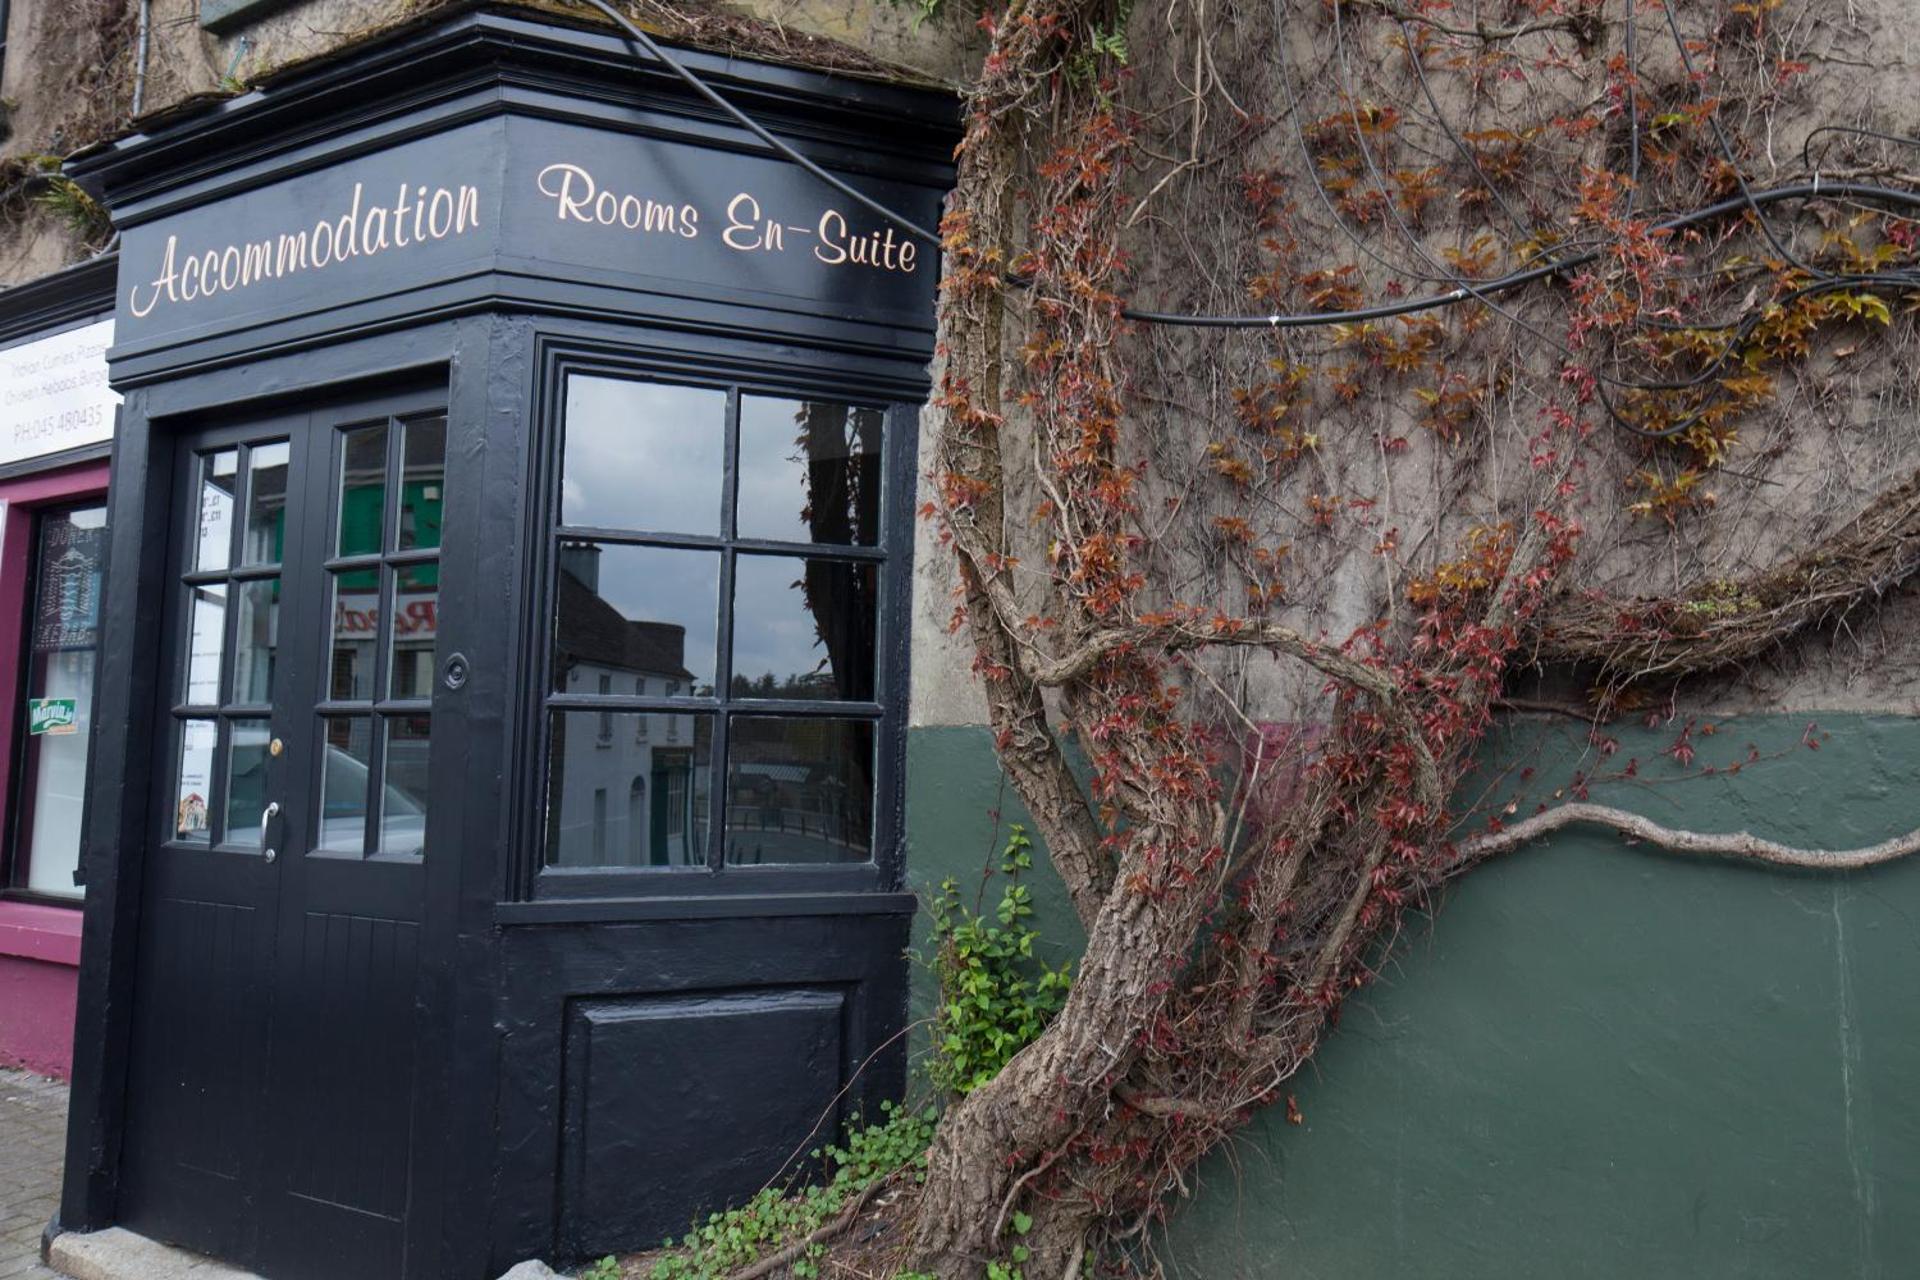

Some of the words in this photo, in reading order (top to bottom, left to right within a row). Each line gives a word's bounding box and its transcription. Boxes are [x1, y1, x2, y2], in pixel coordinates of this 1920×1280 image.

[129, 182, 480, 318] Accommodation
[537, 163, 699, 239] Rooms
[721, 192, 916, 273] En-Suite
